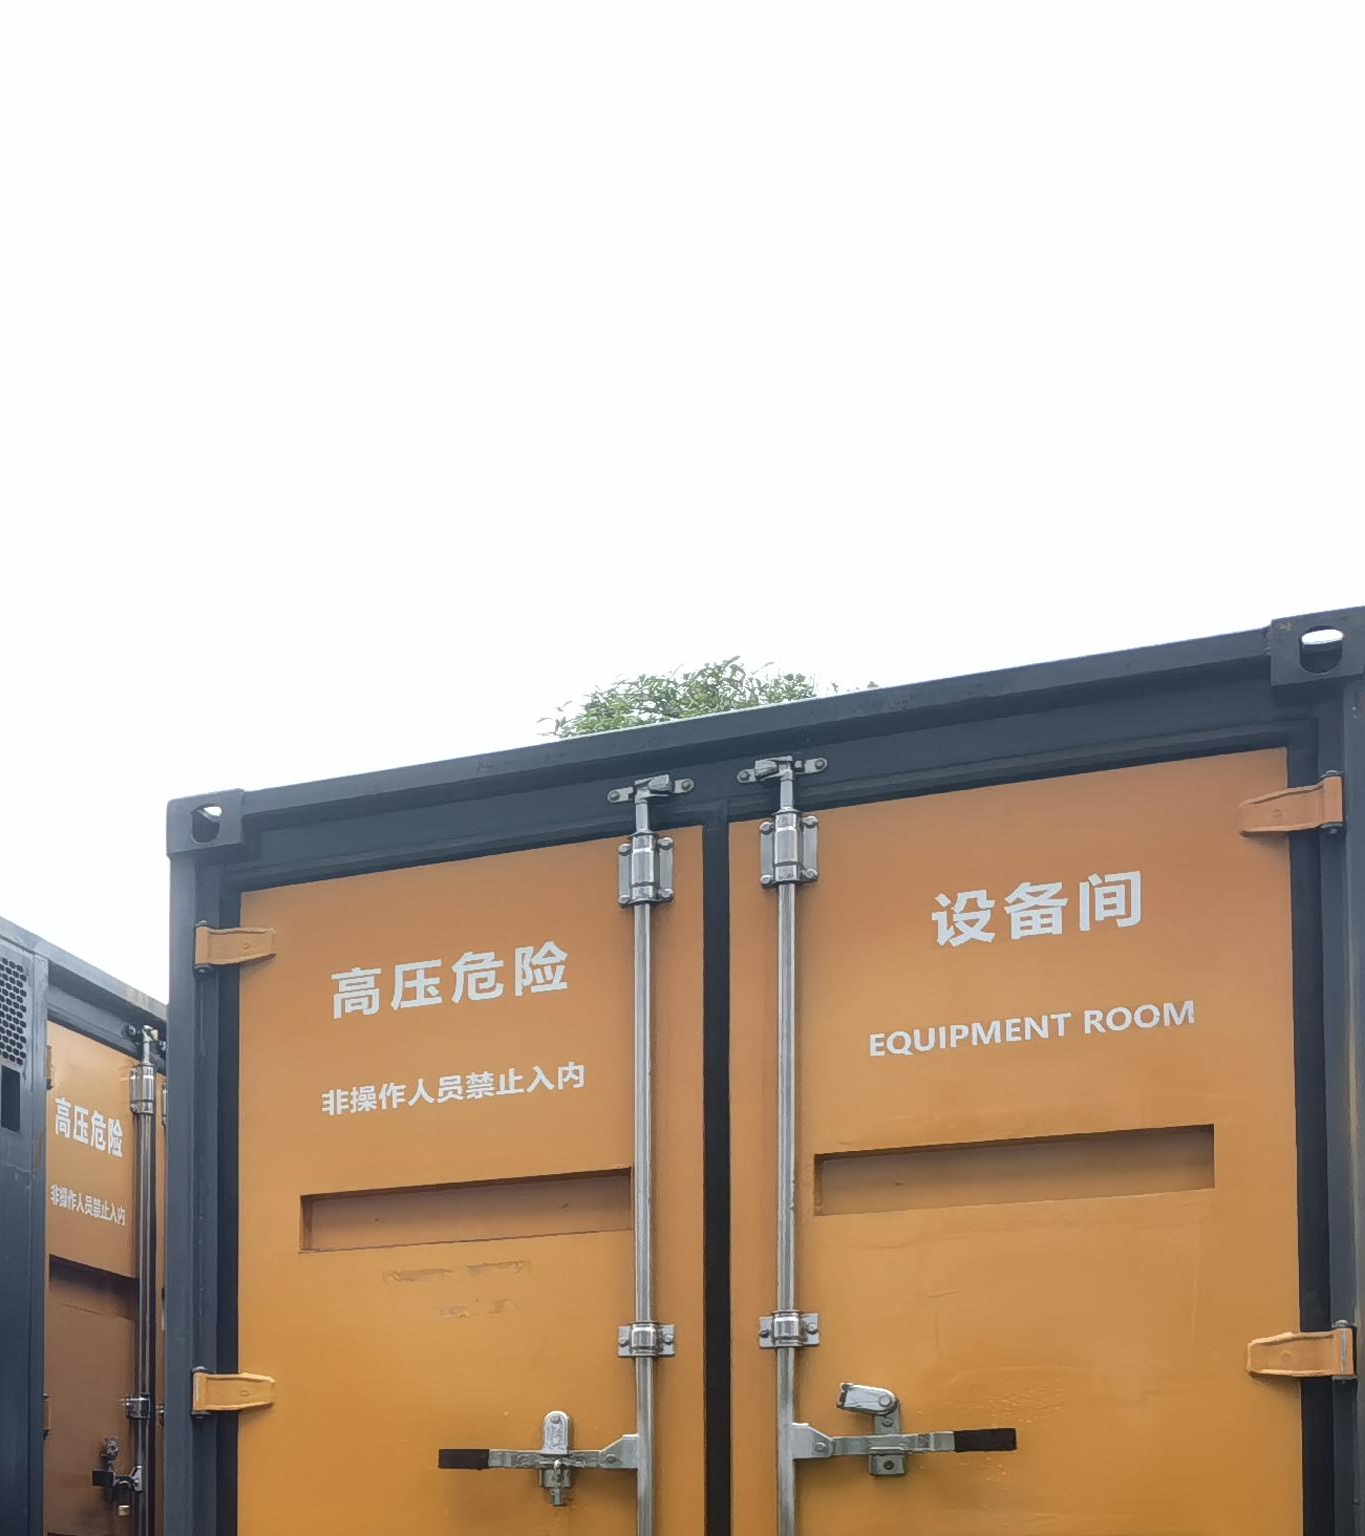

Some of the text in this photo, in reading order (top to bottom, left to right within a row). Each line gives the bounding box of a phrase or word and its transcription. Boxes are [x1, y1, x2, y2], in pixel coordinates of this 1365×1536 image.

[932, 870, 1141, 947] 设备间
[331, 941, 569, 1019] 高压危险
[869, 1000, 1195, 1057] EQUIPMENT ROOM
[322, 1061, 585, 1116] 非操作人员禁止入内
[55, 1097, 123, 1158] 高压危险
